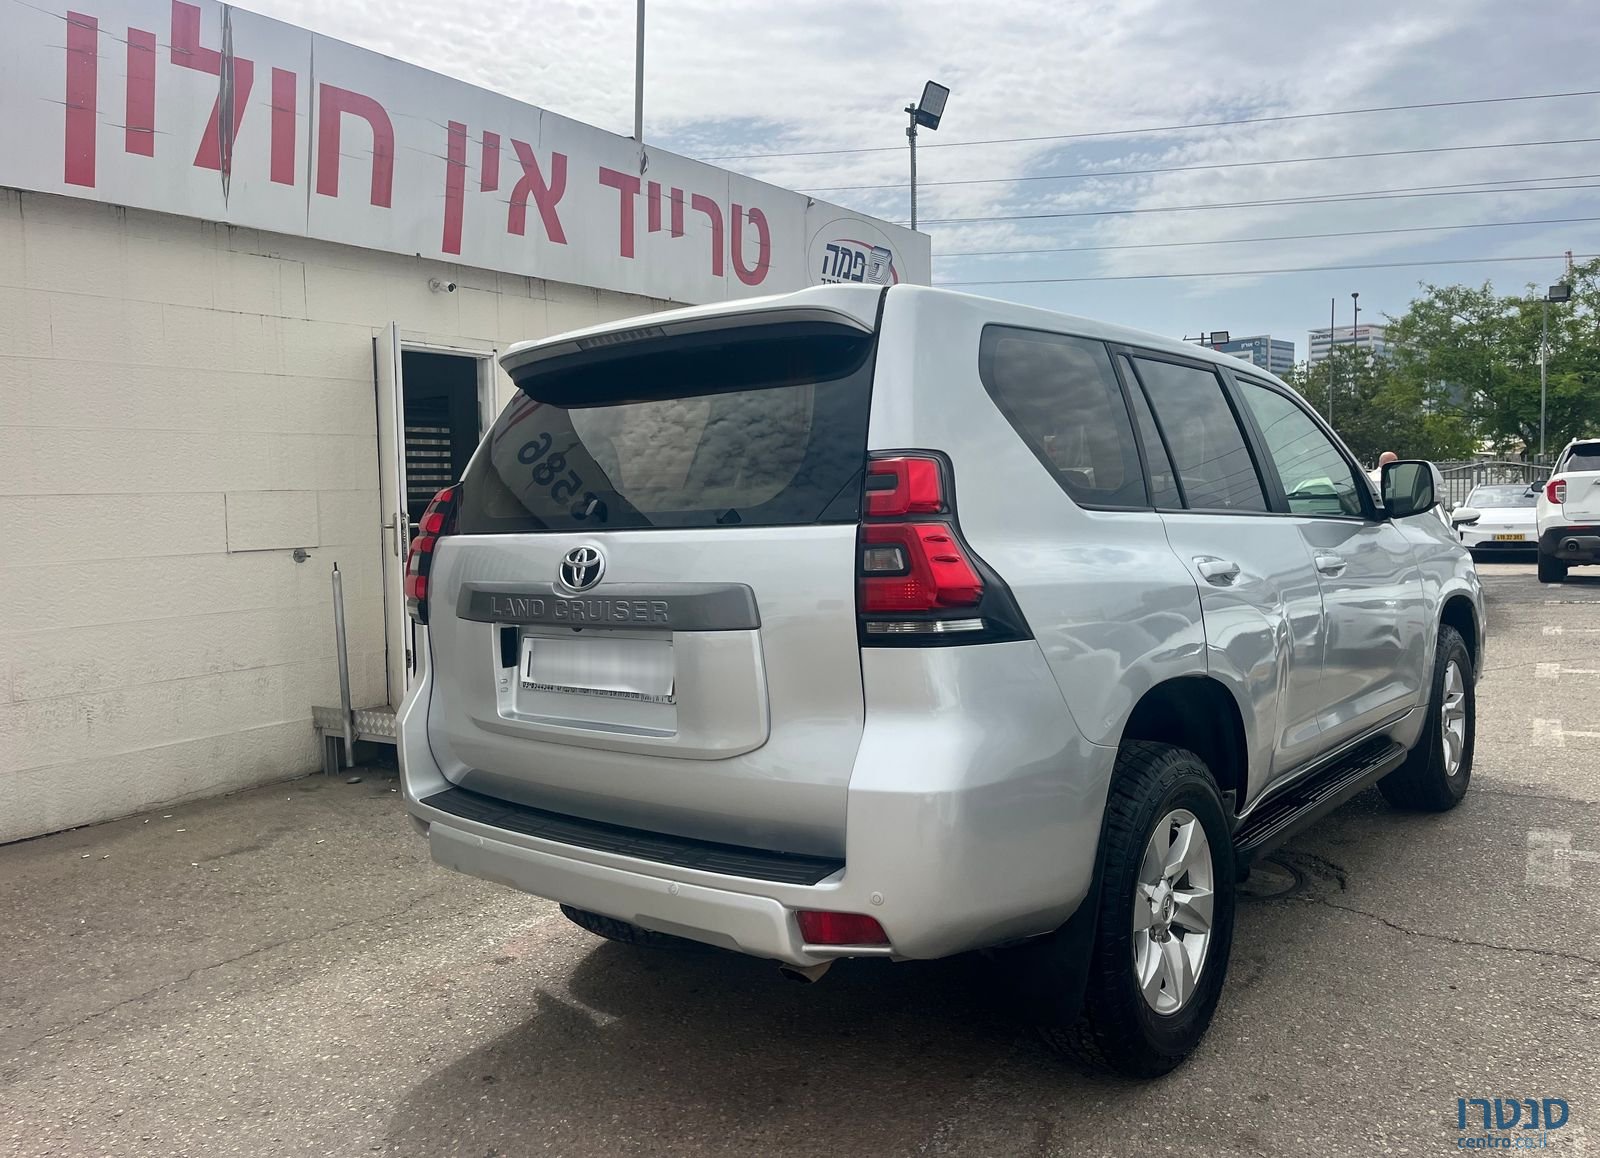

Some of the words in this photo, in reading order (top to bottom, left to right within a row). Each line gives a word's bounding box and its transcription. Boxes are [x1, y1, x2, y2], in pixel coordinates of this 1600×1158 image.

[64, 0, 394, 208] חולון
[441, 120, 568, 255] אין
[599, 166, 771, 286] טרייד
[822, 243, 866, 283] פמה
[490, 596, 545, 618] LAND
[554, 599, 669, 622] CRUISER
